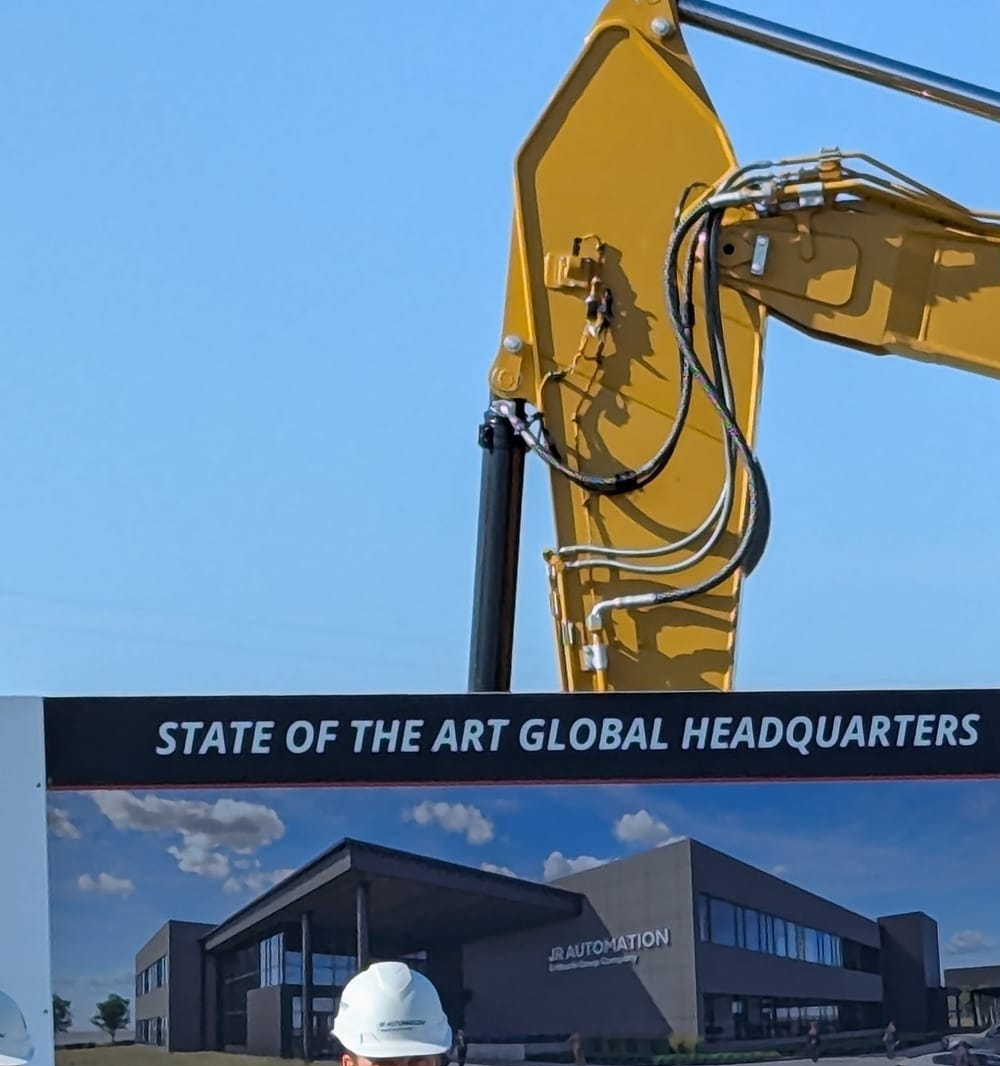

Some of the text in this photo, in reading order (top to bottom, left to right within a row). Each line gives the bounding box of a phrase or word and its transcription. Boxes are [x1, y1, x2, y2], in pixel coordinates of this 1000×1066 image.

[155, 713, 981, 755] STATE OF THE ART GLOBAL HEADQUARTERS
[565, 927, 670, 960] AUTOMATION
